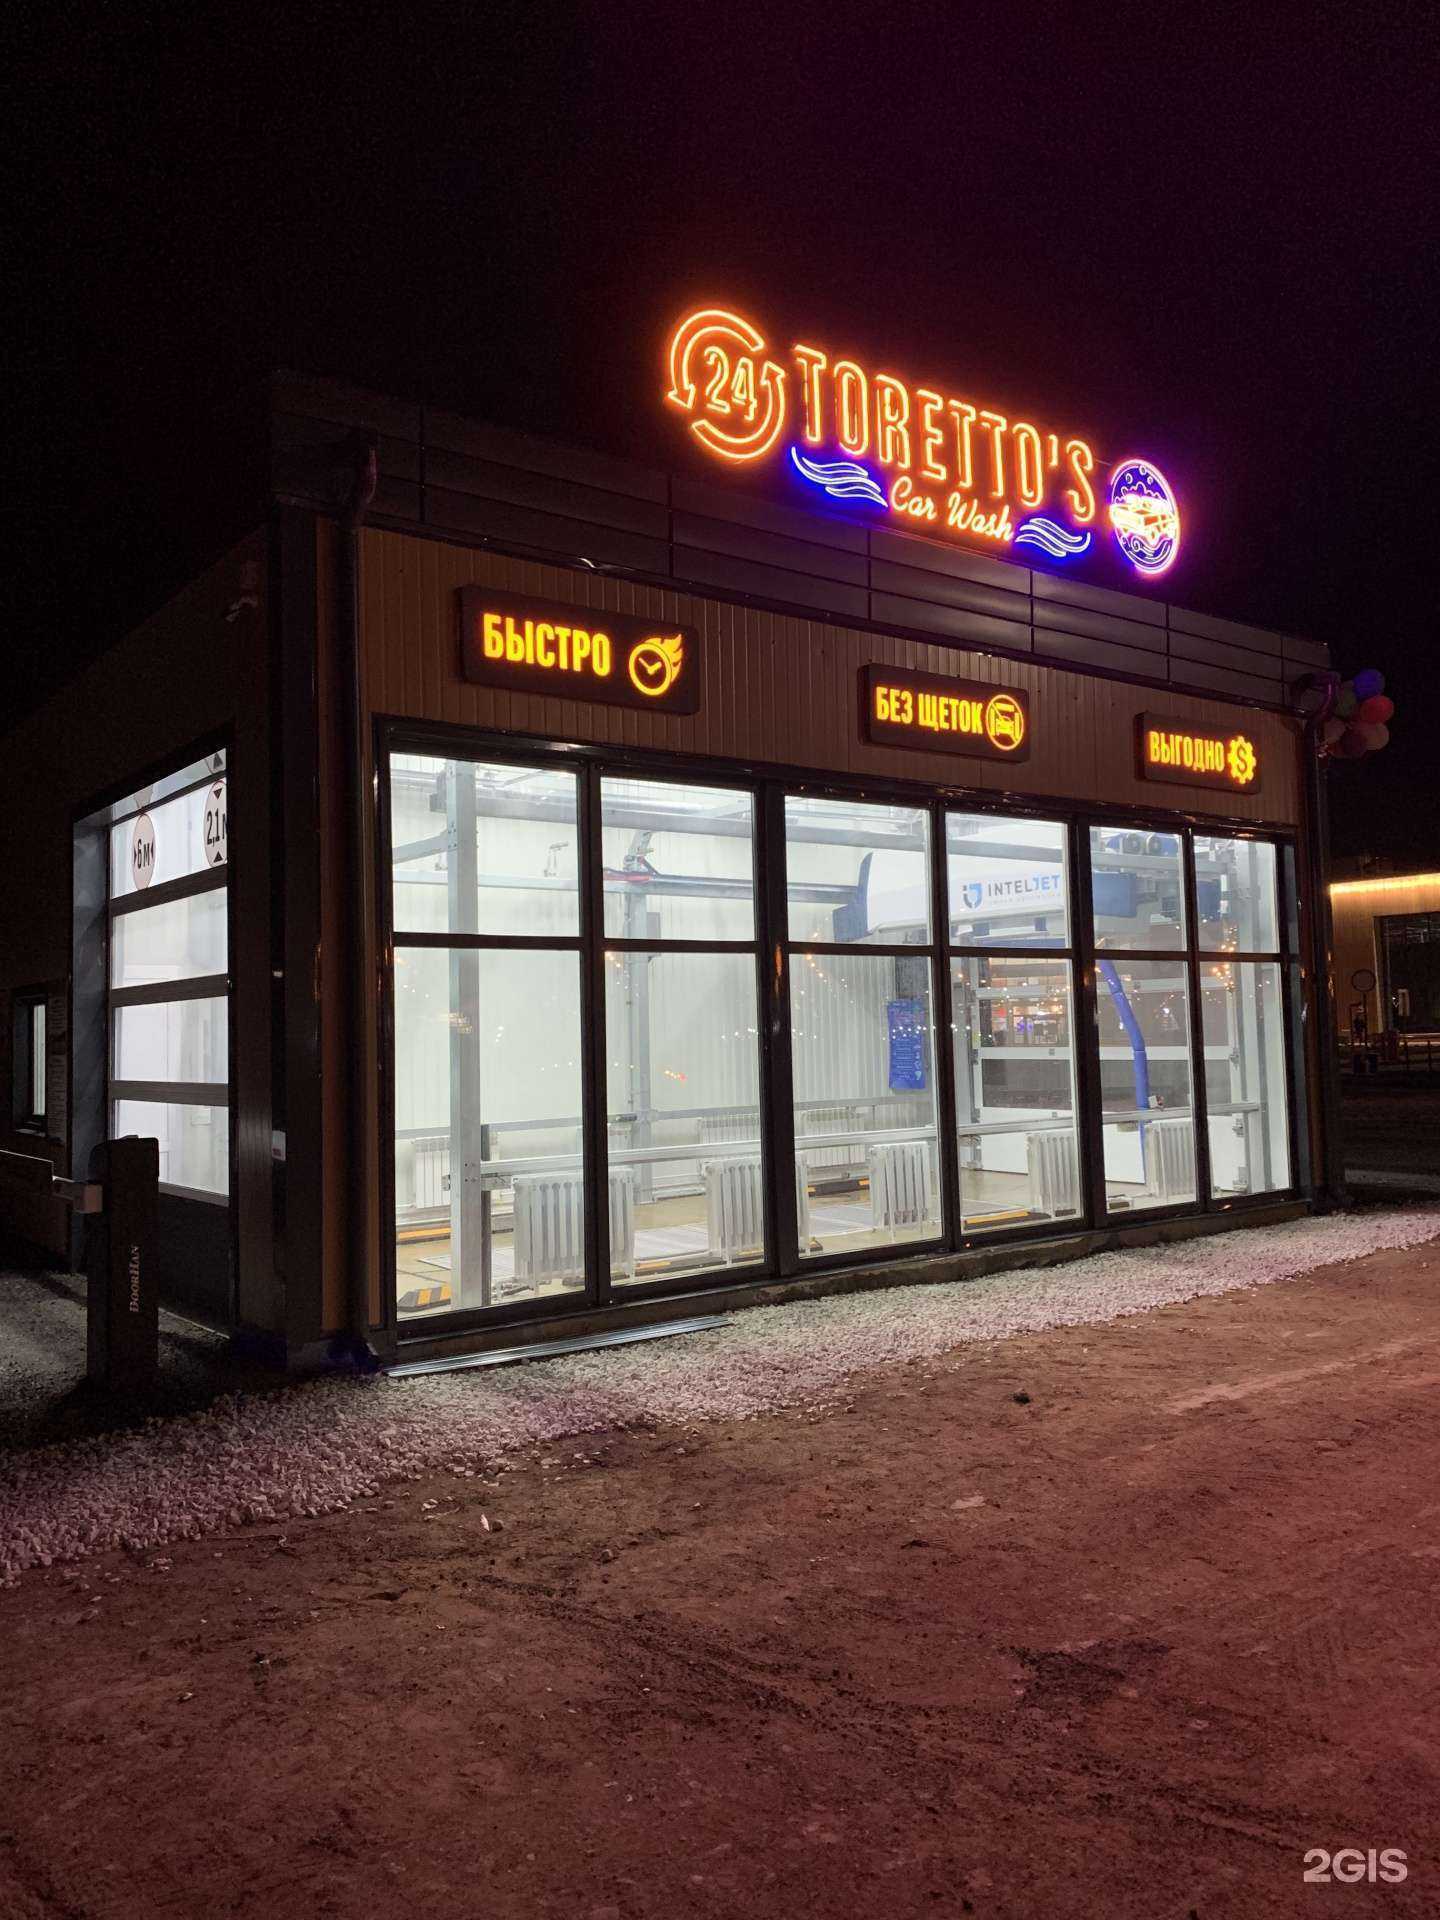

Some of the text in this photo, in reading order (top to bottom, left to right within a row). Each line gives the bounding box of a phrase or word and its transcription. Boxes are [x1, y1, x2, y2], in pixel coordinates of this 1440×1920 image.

[703, 345, 758, 422] 24
[794, 343, 1096, 523] TORETTO'S
[890, 474, 1015, 541] Car Wash
[482, 612, 612, 678] БЫСТРО
[875, 685, 984, 735] БЕЗ ЩЕТОК
[1148, 730, 1225, 772] ВЫГОДНО
[988, 875, 1060, 897] INTELJET
